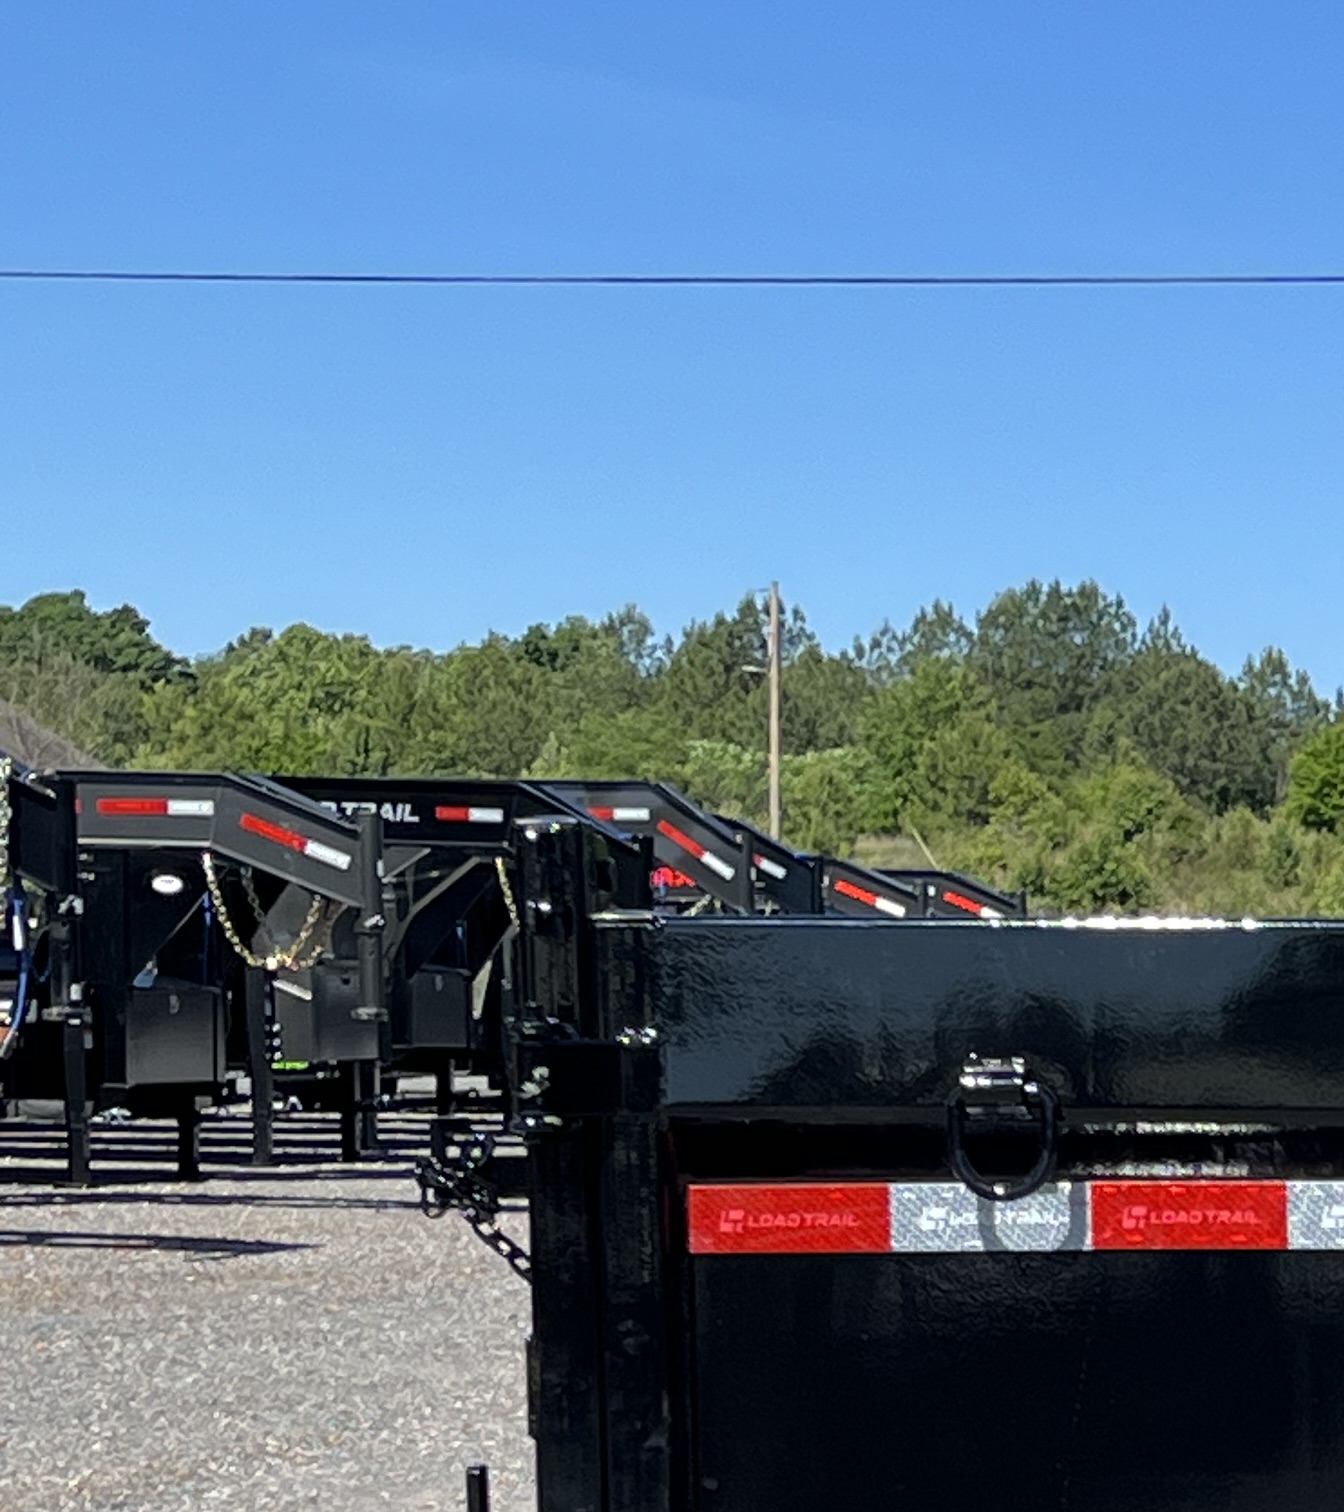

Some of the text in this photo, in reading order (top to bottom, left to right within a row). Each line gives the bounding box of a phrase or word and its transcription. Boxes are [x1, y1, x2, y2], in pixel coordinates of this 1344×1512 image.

[746, 1211, 860, 1228] LOAD TRAIL
[1150, 1209, 1262, 1225] LOAD TRAIL
